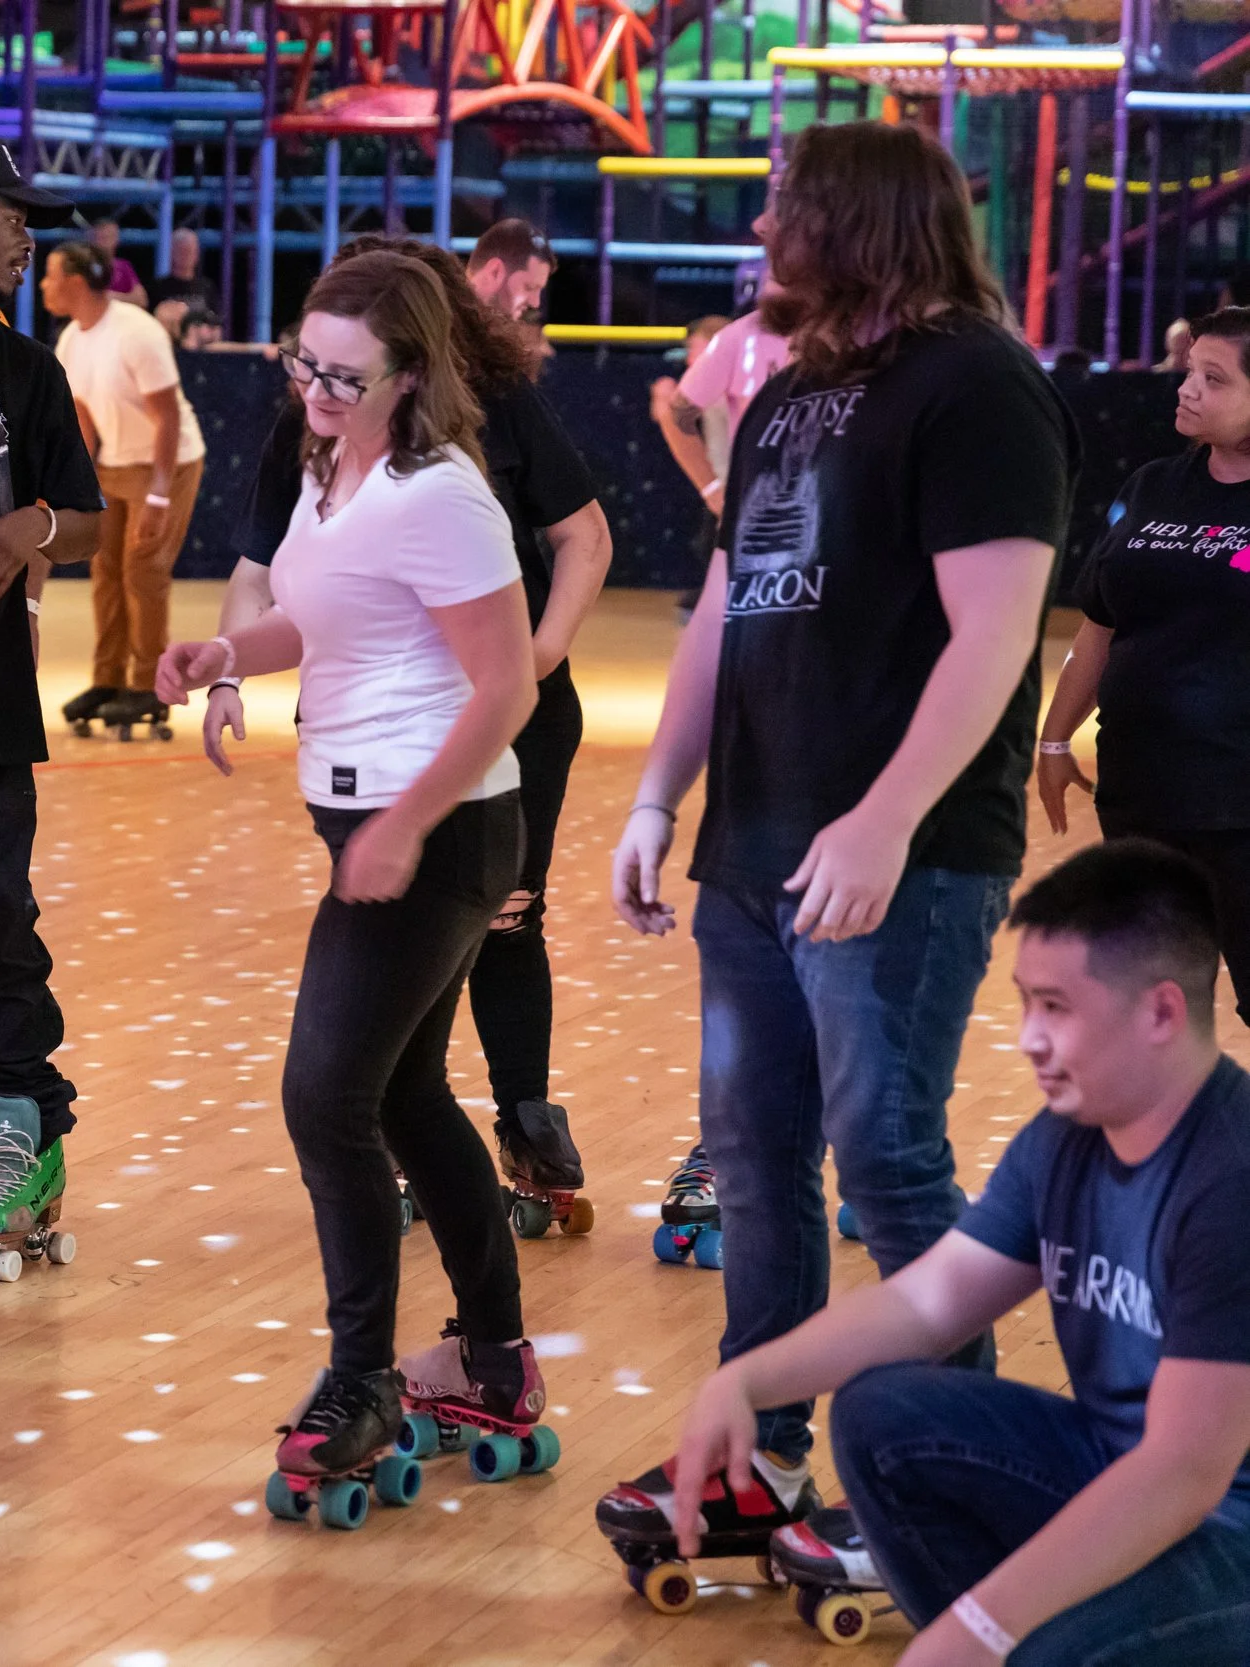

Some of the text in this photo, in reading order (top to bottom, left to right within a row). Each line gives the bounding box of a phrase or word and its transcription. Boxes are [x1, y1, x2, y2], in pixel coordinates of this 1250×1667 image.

[757, 391, 865, 448] HOUSE
[1140, 521, 1188, 537] HER
[1150, 540, 1190, 550] our
[1193, 535, 1248, 558] fight
